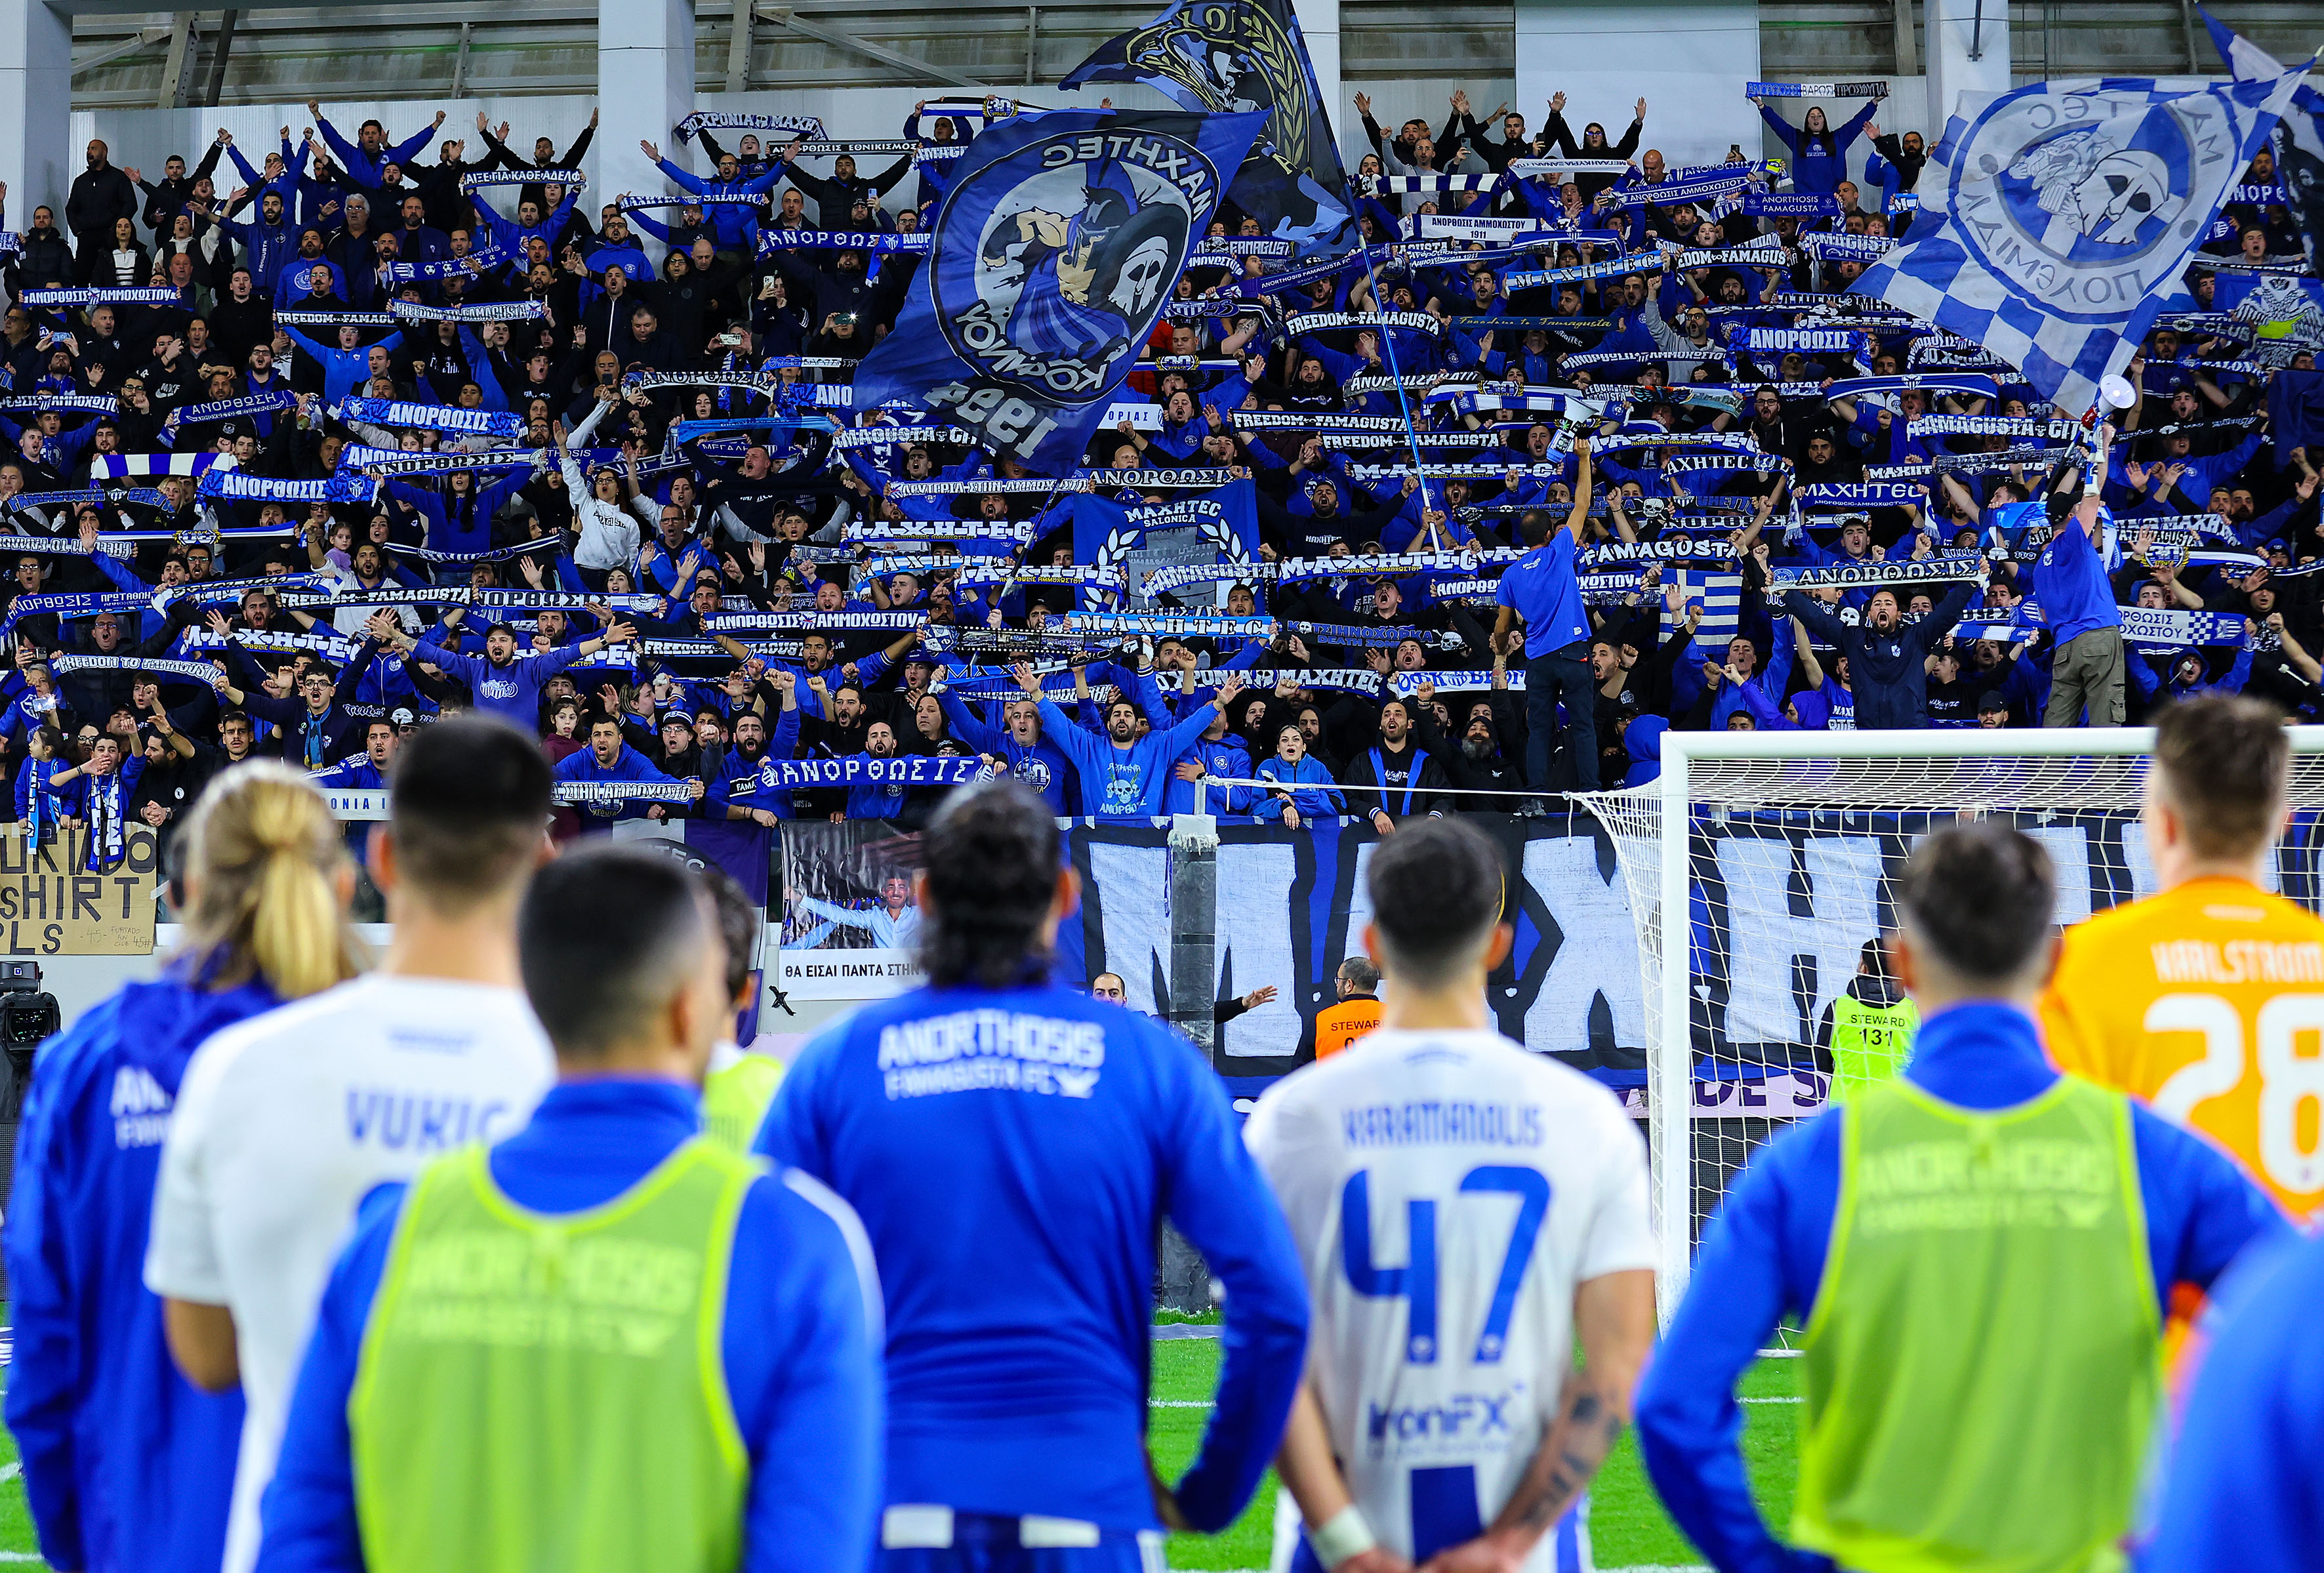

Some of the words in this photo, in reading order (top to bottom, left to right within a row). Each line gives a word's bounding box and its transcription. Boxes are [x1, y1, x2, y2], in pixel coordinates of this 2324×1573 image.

[773, 145, 841, 155] ΑΝΡΘΩΣΙΣ
[541, 170, 581, 182] ΑΔΕΛΦ
[1680, 178, 1742, 195] ΑΜΜΟΧΩΣΤΟΥ
[1762, 195, 1819, 204] ANORTHOSIS
[1763, 204, 1819, 213] FAMAGUSTA
[1431, 217, 1473, 227] ΑΝΟΡΘΩΣΙΣ
[1473, 218, 1526, 229] ΑΜΜΟΧΩΣΤΟΥ
[1470, 230, 1486, 239] 1911
[1230, 241, 1290, 256] FAMAGUST
[277, 312, 333, 323] FREEDOM
[1288, 312, 1348, 335] FREEDOM
[1749, 329, 1850, 350] ΑΝΟΡΘΩΣΙΣ
[388, 407, 494, 432] ΑΝΟΡΘΩΣΙΣ
[1234, 413, 1303, 428] FREEDOM
[1323, 434, 1394, 449] FREEDOM
[222, 478, 327, 500] ΑΝΟΡΘΩΣΙΣ
[1143, 515, 1196, 527] SALONICA
[816, 613, 918, 628] ΑΜΜΟΧΩΣΤΟΥ
[781, 758, 975, 783] ΑΝΟΡΘΩΣΙΣ
[0, 922, 64, 954] LS
[785, 964, 802, 977] ΘΑ
[806, 964, 837, 977] ΕΙΣΑΙ
[841, 964, 884, 978] ΠΑΝΤΑ
[1850, 1014, 1906, 1029] STEWARD
[879, 1008, 1106, 1071] ANORTHOSIS
[1858, 1029, 1894, 1047] 131
[2144, 993, 2324, 1195] 28
[1343, 1166, 1552, 1364] 47
